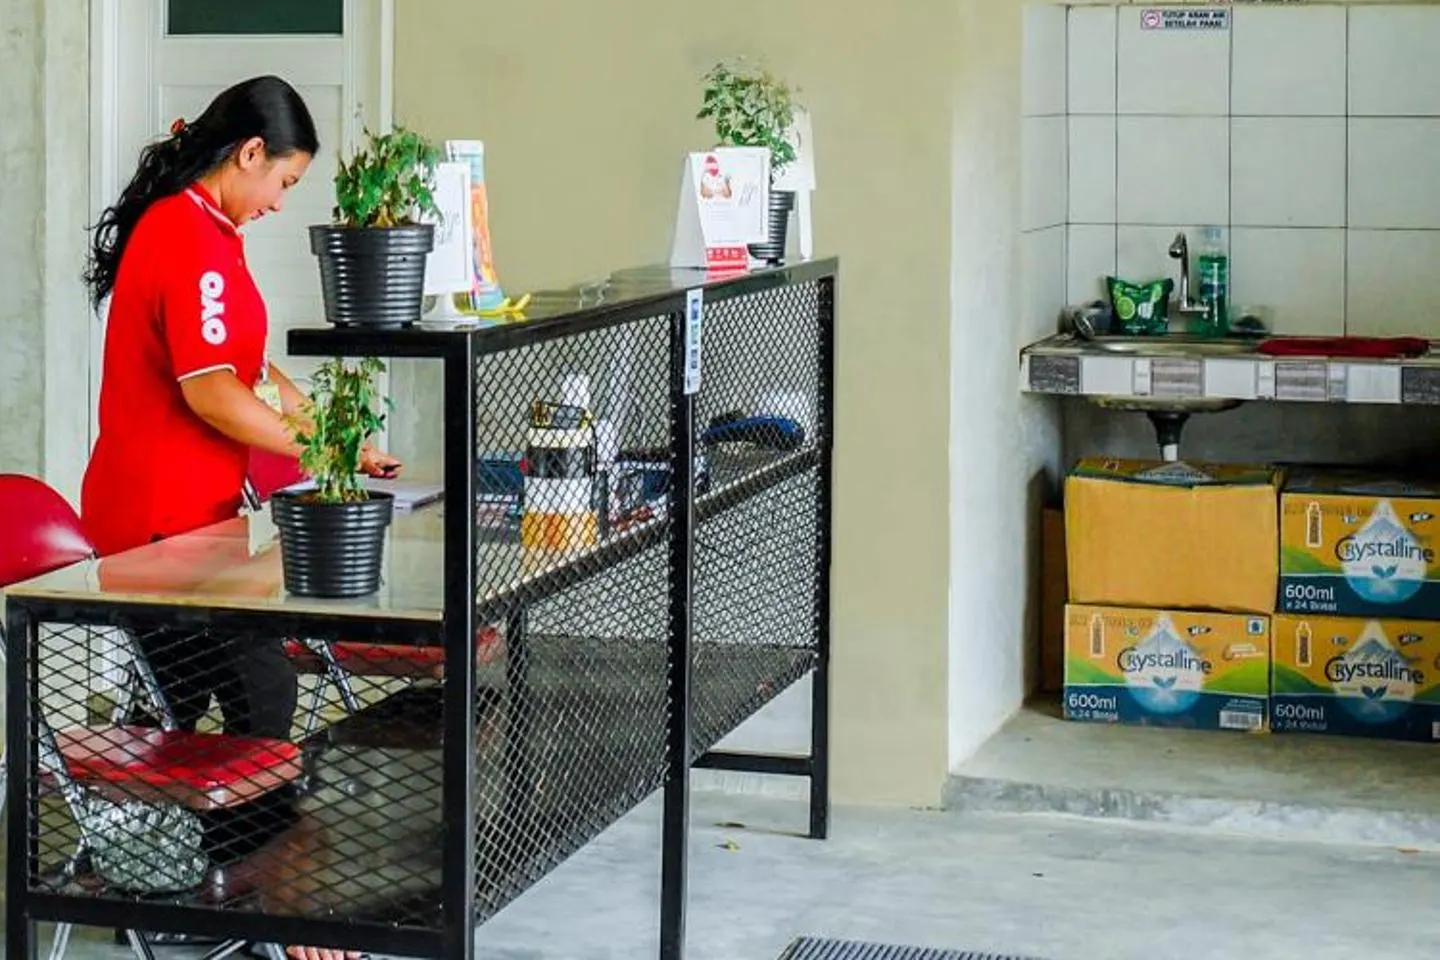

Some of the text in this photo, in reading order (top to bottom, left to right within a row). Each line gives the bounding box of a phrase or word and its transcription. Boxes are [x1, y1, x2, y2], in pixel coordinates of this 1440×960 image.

[199, 271, 227, 345] OYO
[1285, 584, 1334, 600] 600ml
[1295, 600, 1307, 609] 24
[1069, 693, 1116, 710] 600ml
[1275, 703, 1324, 720] 600ml
